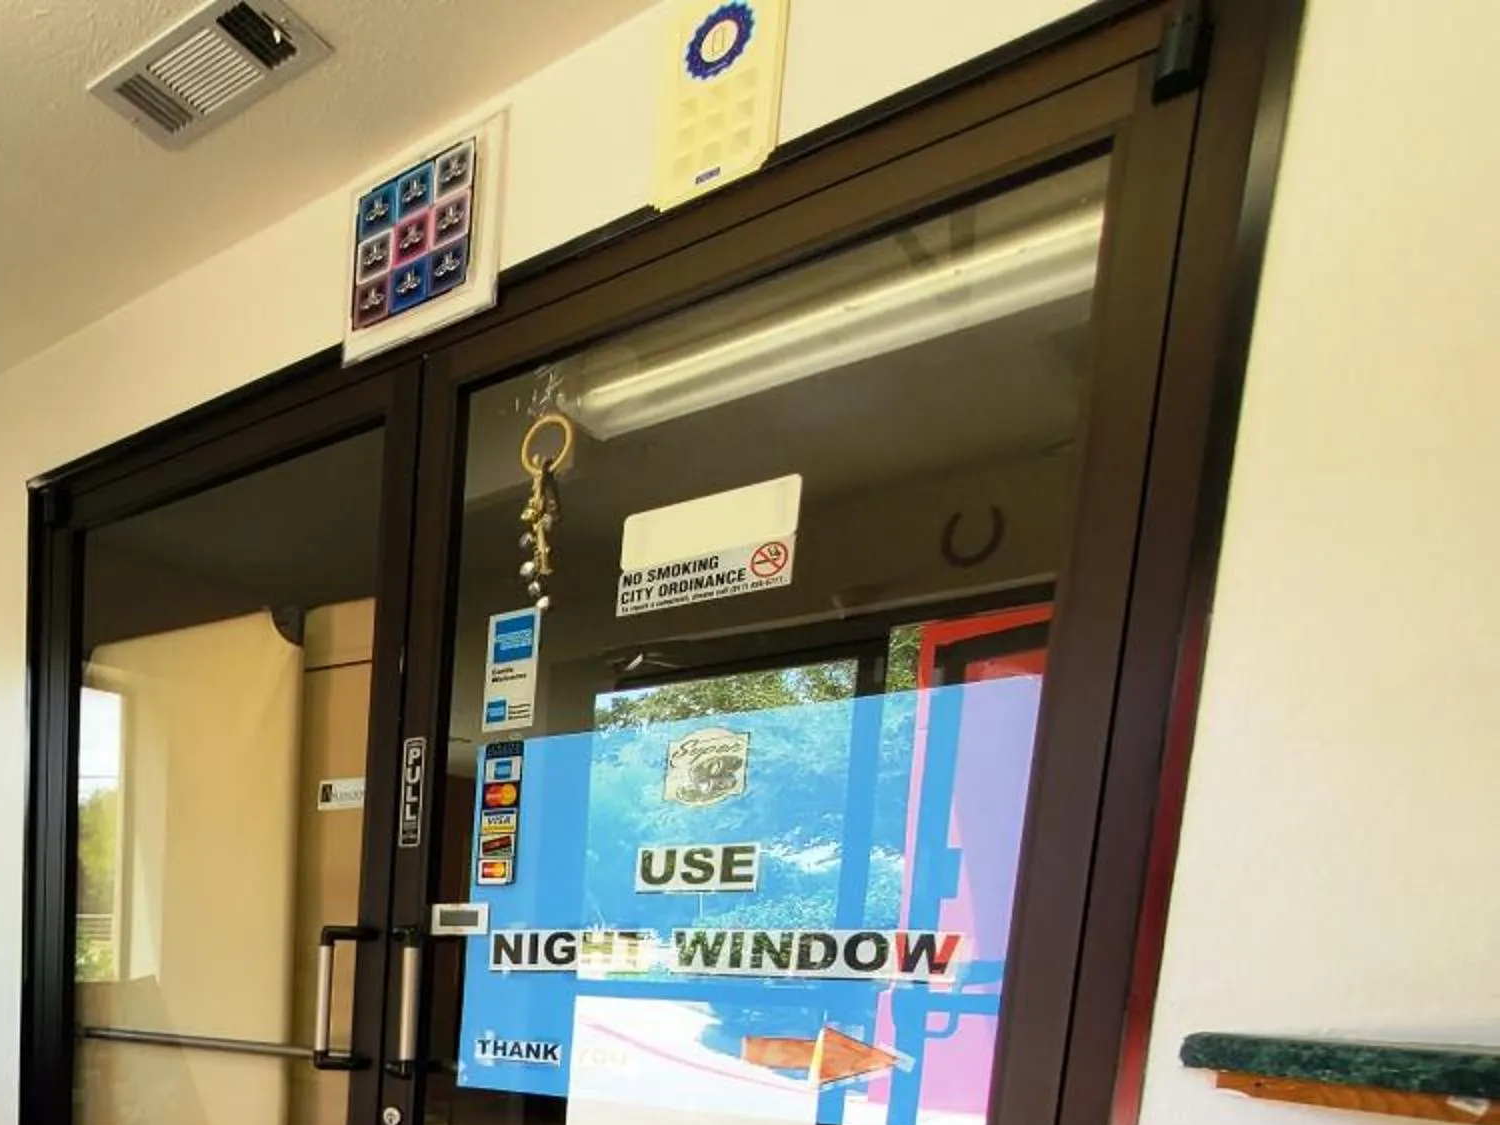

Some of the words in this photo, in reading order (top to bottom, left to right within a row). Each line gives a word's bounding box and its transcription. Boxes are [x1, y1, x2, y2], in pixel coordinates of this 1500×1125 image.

[620, 586, 654, 606] CITY
[658, 567, 747, 598] ORDINANCE
[621, 572, 643, 590] NO
[647, 555, 719, 584] SMOKING
[669, 738, 743, 767] Super
[405, 746, 421, 821] PULL
[640, 845, 757, 886] USE
[491, 931, 648, 966] NIGHT
[672, 930, 963, 976] WINDOW
[477, 1038, 560, 1062] THANK
